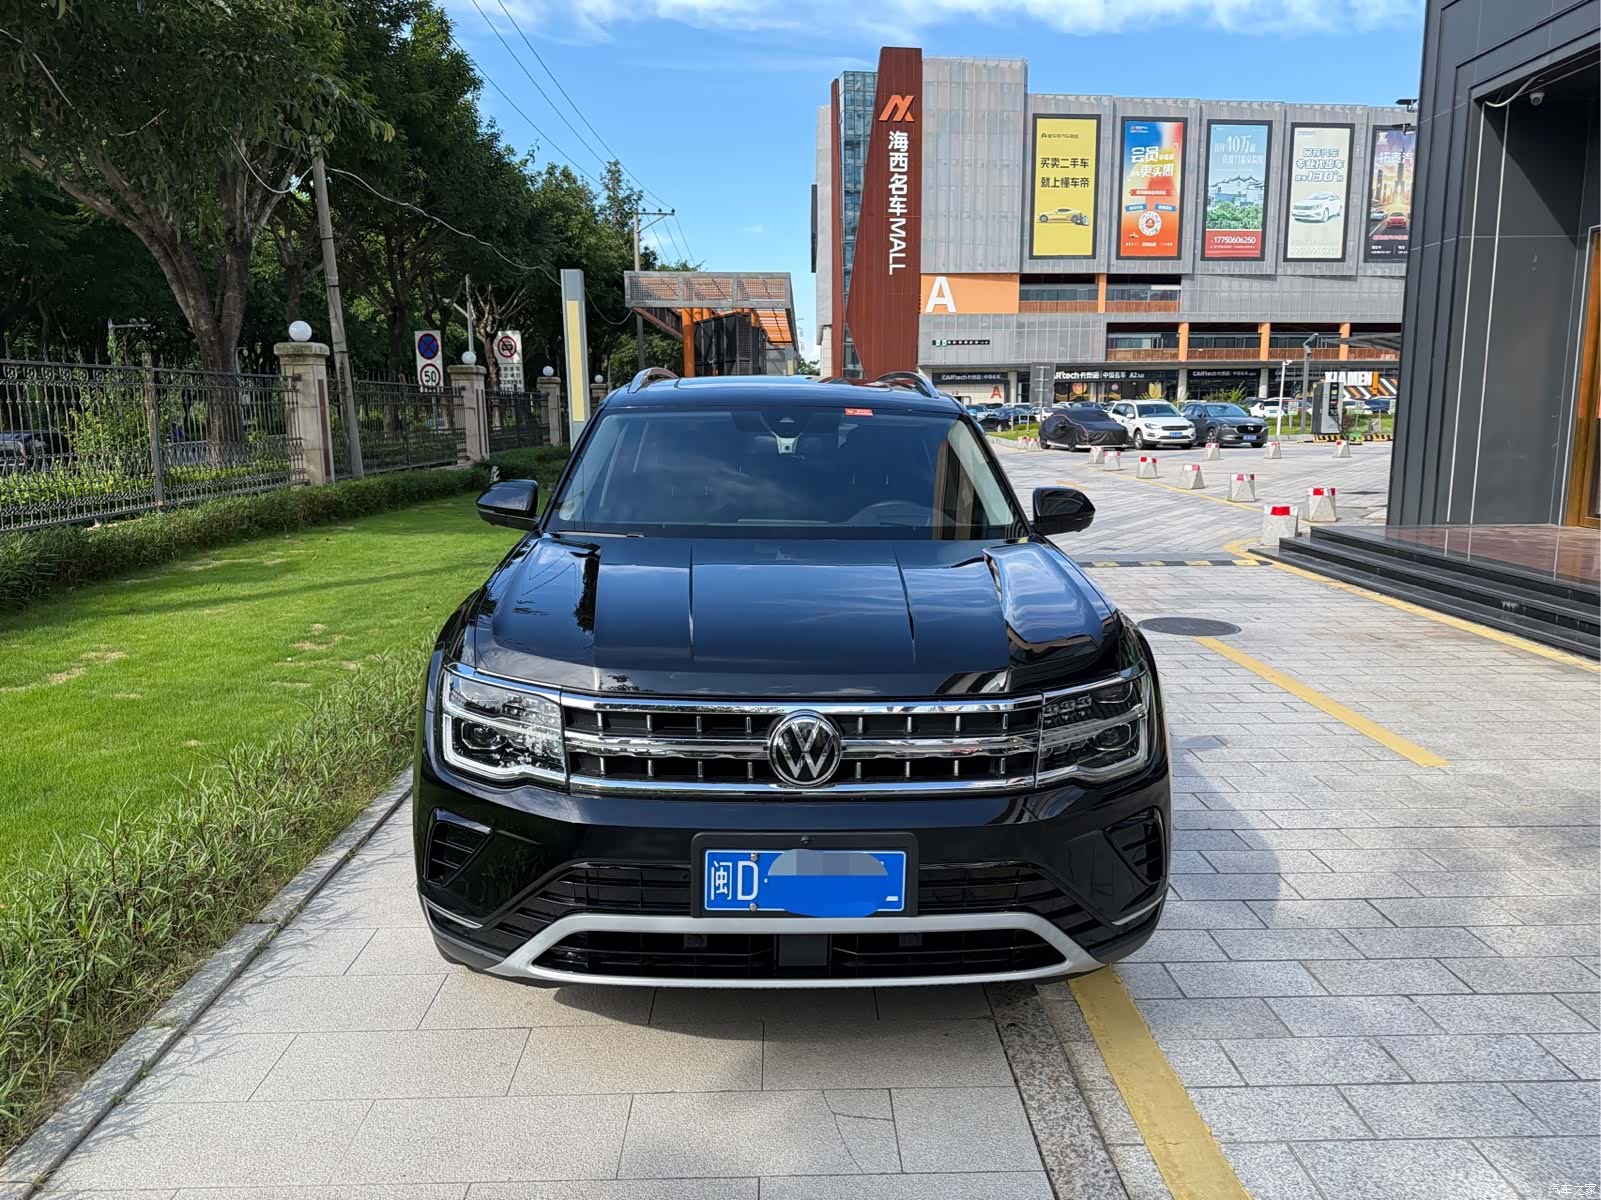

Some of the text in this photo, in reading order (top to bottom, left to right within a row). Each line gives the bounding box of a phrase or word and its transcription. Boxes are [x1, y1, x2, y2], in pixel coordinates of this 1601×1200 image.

[1040, 157, 1090, 169] 买卖二手车
[1296, 159, 1345, 169] 专业代步车
[1040, 177, 1090, 188] 就上懂车帝
[925, 276, 957, 313] A
[424, 371, 437, 383] 50
